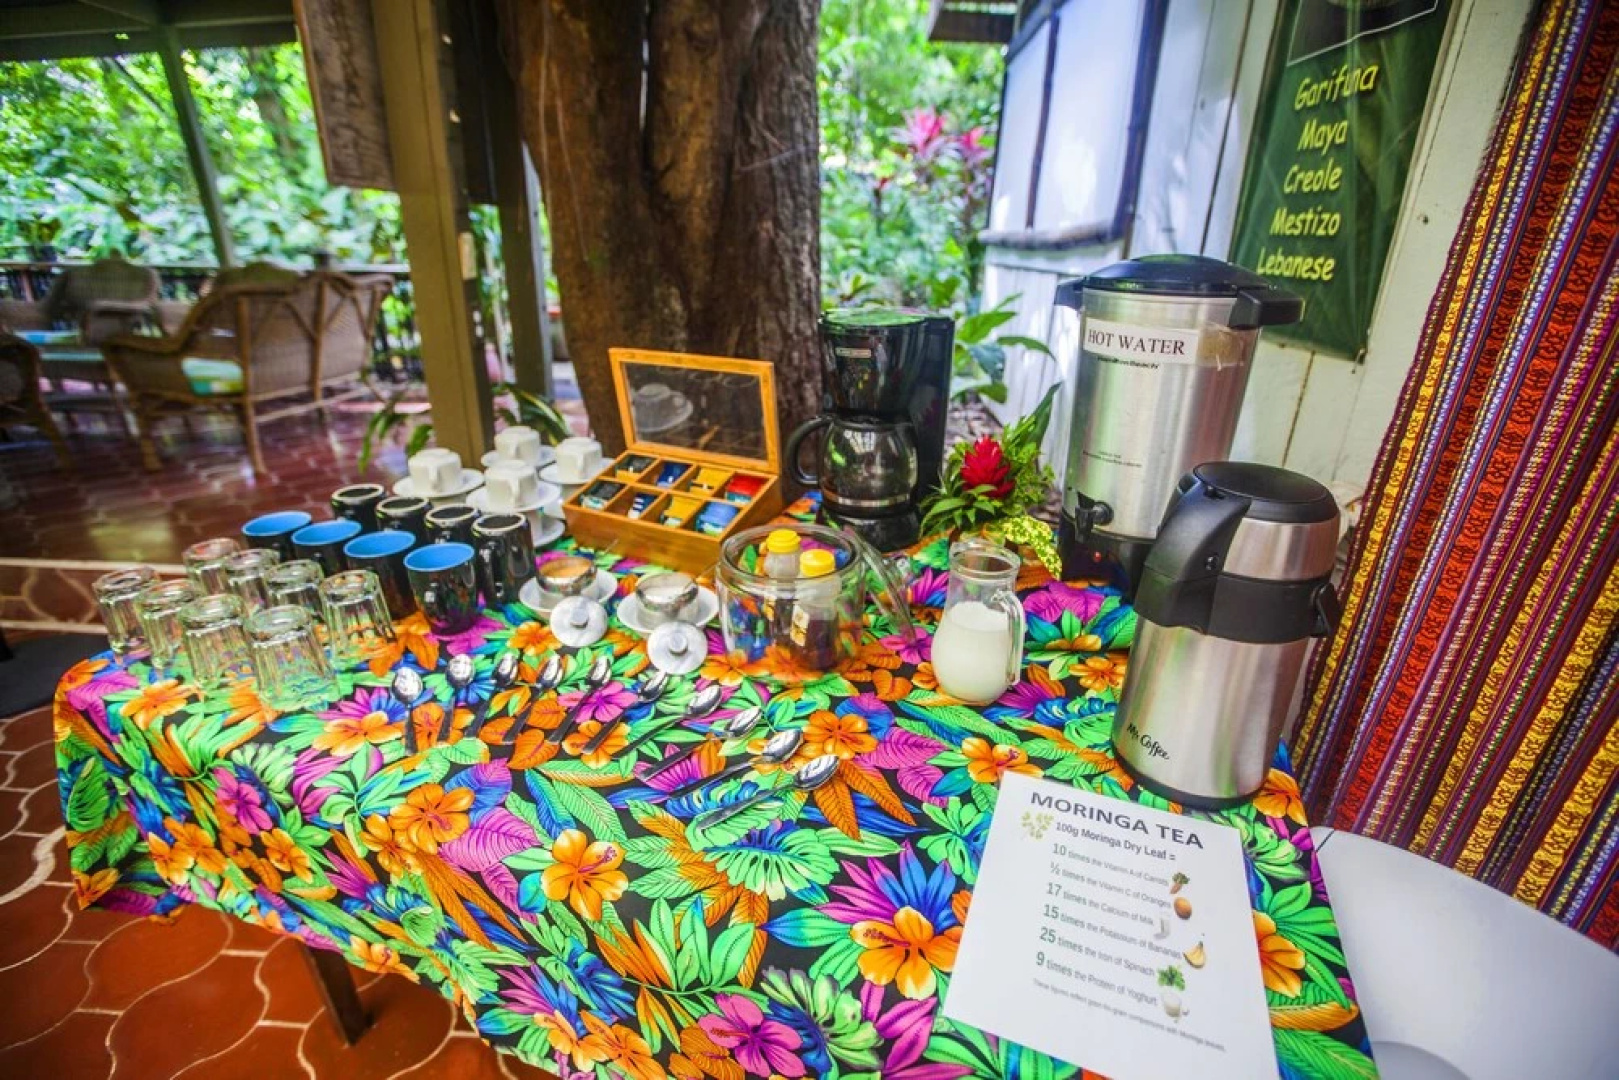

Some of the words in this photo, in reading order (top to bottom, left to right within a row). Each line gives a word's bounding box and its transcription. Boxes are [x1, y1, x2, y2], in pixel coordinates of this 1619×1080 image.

[1294, 63, 1379, 110] Garifuna
[1297, 119, 1348, 155] Maya
[1283, 157, 1342, 194] Creole
[1269, 205, 1341, 236] Mestizo
[1256, 248, 1336, 281] Lebanese
[1087, 329, 1114, 347] HOT
[1118, 334, 1185, 355] WATER
[1140, 734, 1170, 760] Coffee
[1030, 791, 1149, 835] MORINGA
[1155, 823, 1204, 849] TEA
[1052, 843, 1067, 856] 10
[1068, 850, 1091, 864] times
[1056, 821, 1080, 838] 100g
[1081, 828, 1122, 848] Moringa
[1123, 839, 1142, 856] Dry
[1144, 845, 1167, 860] Leaf
[1047, 882, 1062, 897] 17
[1063, 890, 1087, 906] times
[1061, 868, 1086, 883] times
[1125, 887, 1132, 897] C
[1043, 904, 1059, 919] 15
[1060, 913, 1085, 929] times
[1040, 926, 1056, 943] 25
[1057, 936, 1083, 953] times
[1036, 951, 1045, 966] 9
[1046, 959, 1072, 977] times
[1074, 970, 1087, 982] the
[1127, 987, 1158, 1006] Yoghurt
